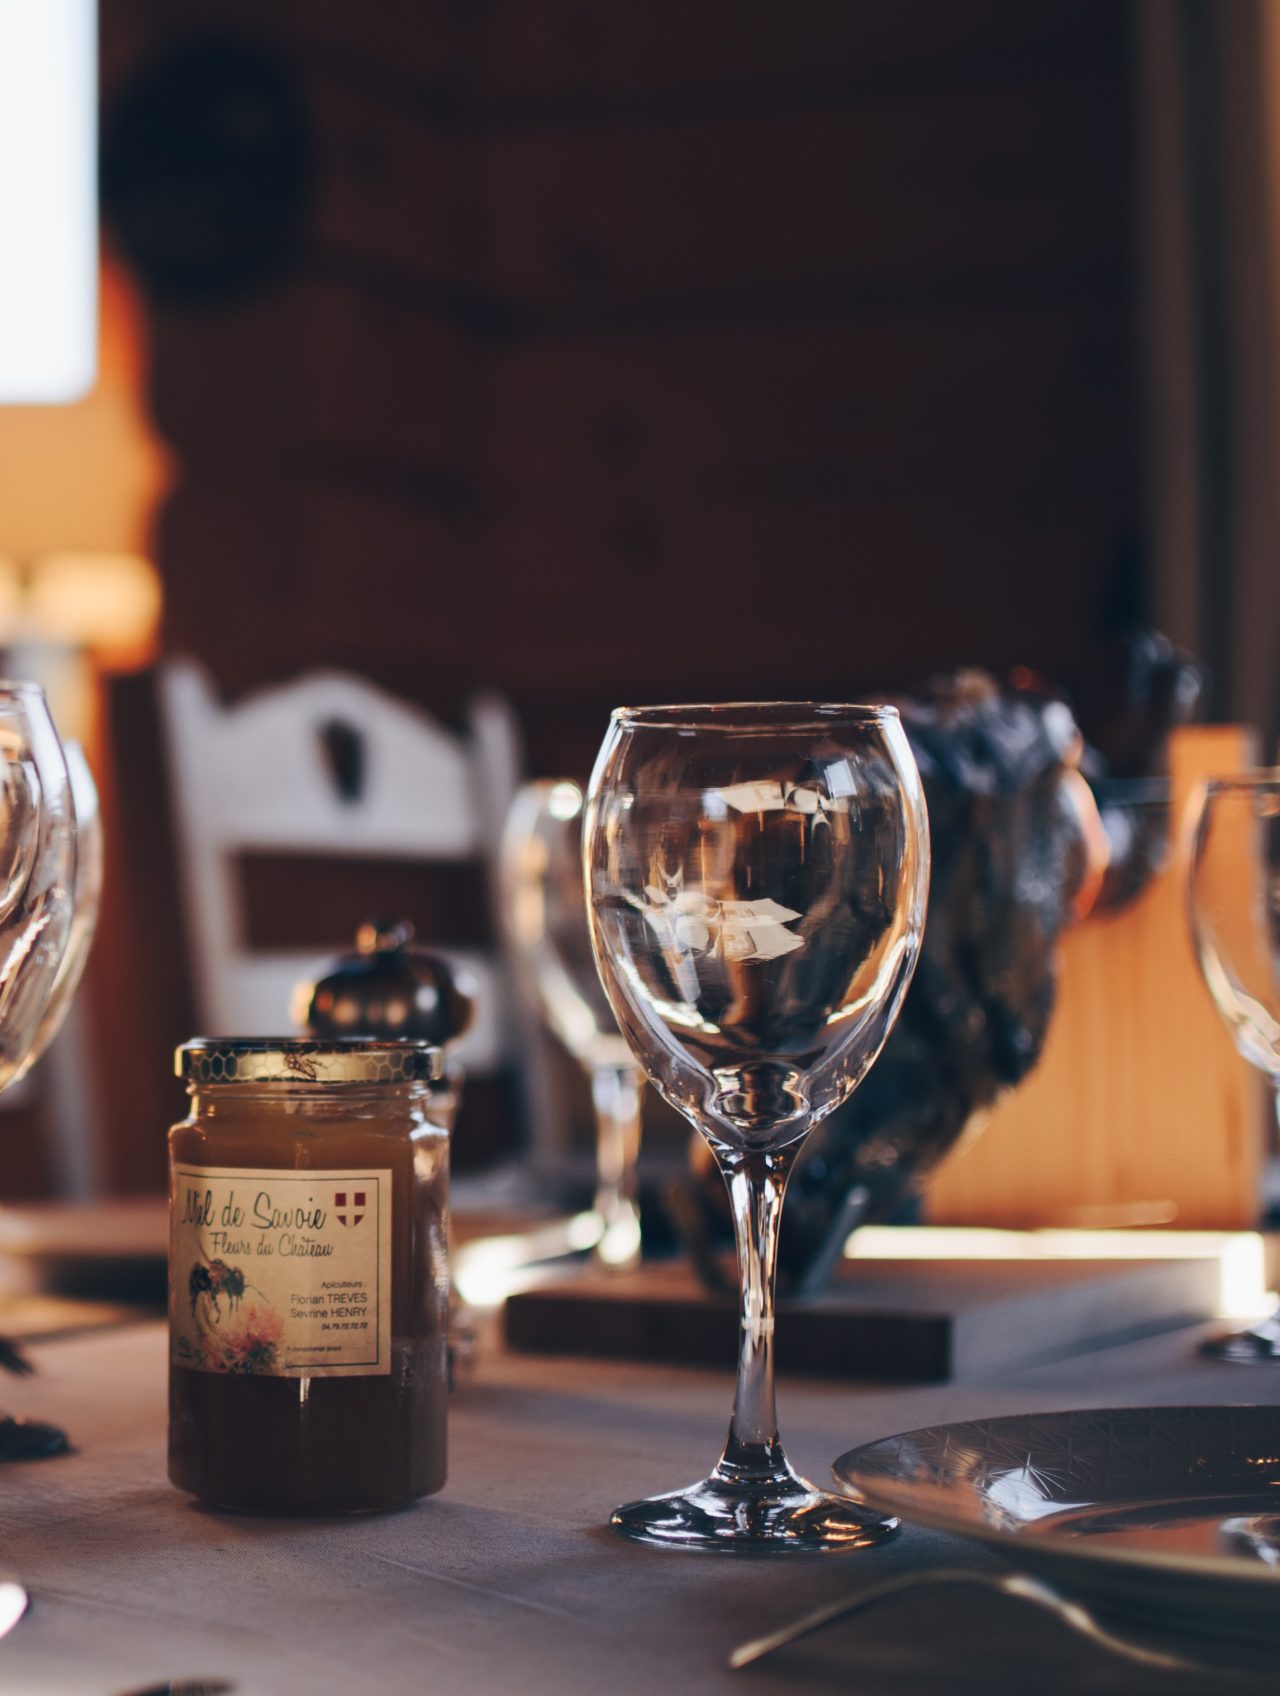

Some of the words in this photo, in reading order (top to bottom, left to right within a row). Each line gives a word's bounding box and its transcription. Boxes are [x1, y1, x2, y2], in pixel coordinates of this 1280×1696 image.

[221, 1191, 245, 1227] de
[251, 1191, 327, 1230] Savoie
[209, 1231, 251, 1255] Fleurs
[256, 1233, 274, 1256] du
[279, 1233, 334, 1257] Château
[290, 1294, 325, 1304] Florian
[327, 1293, 368, 1304] TREVES
[330, 1306, 368, 1317] HENRY
